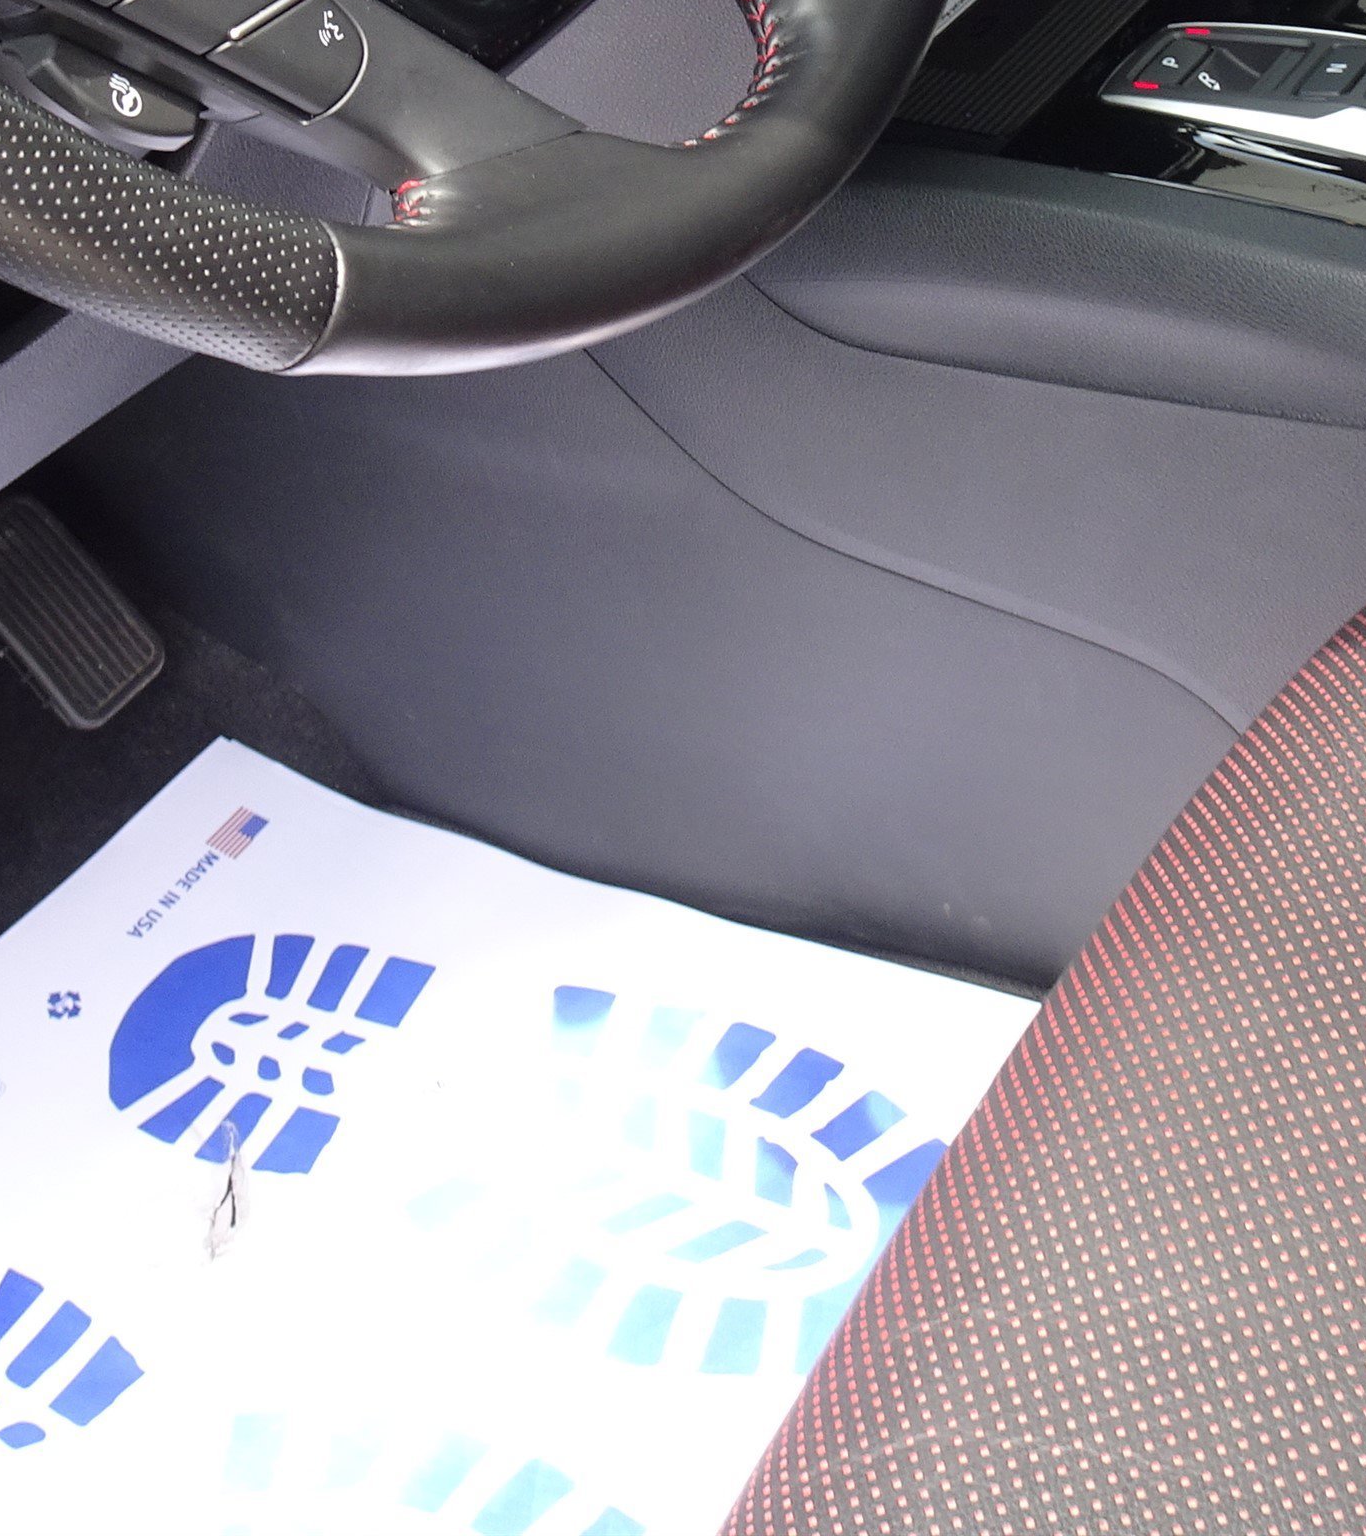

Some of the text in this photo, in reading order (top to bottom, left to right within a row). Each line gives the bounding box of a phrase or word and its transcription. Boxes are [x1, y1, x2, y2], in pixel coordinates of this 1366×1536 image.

[125, 849, 220, 939] MADE IN USA
